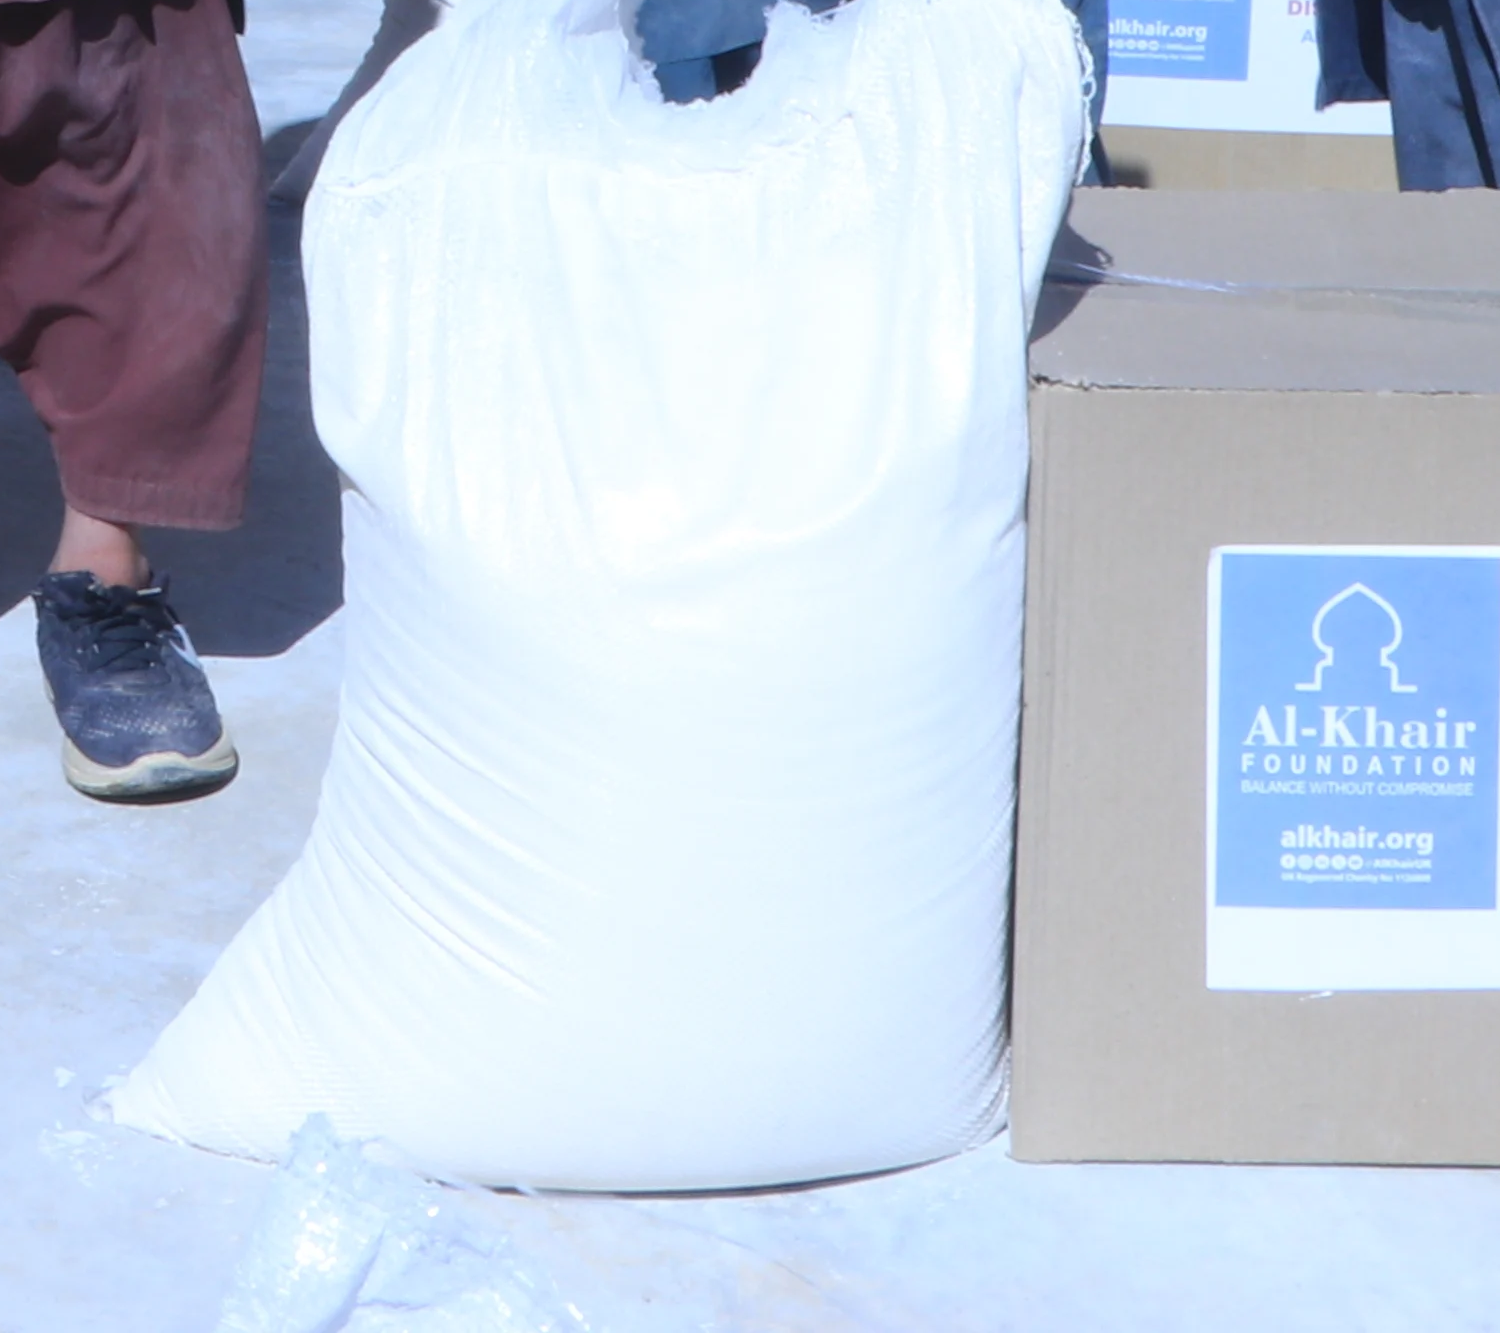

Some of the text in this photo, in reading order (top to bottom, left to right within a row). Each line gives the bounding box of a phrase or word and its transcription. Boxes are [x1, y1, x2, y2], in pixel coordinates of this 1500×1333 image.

[1242, 704, 1476, 749] Al-Khair
[1241, 753, 1475, 776] FOUNDATION
[1241, 780, 1473, 796] BALANCE WITHOUT COMPROMISE
[1281, 825, 1433, 855] alkhair.org
